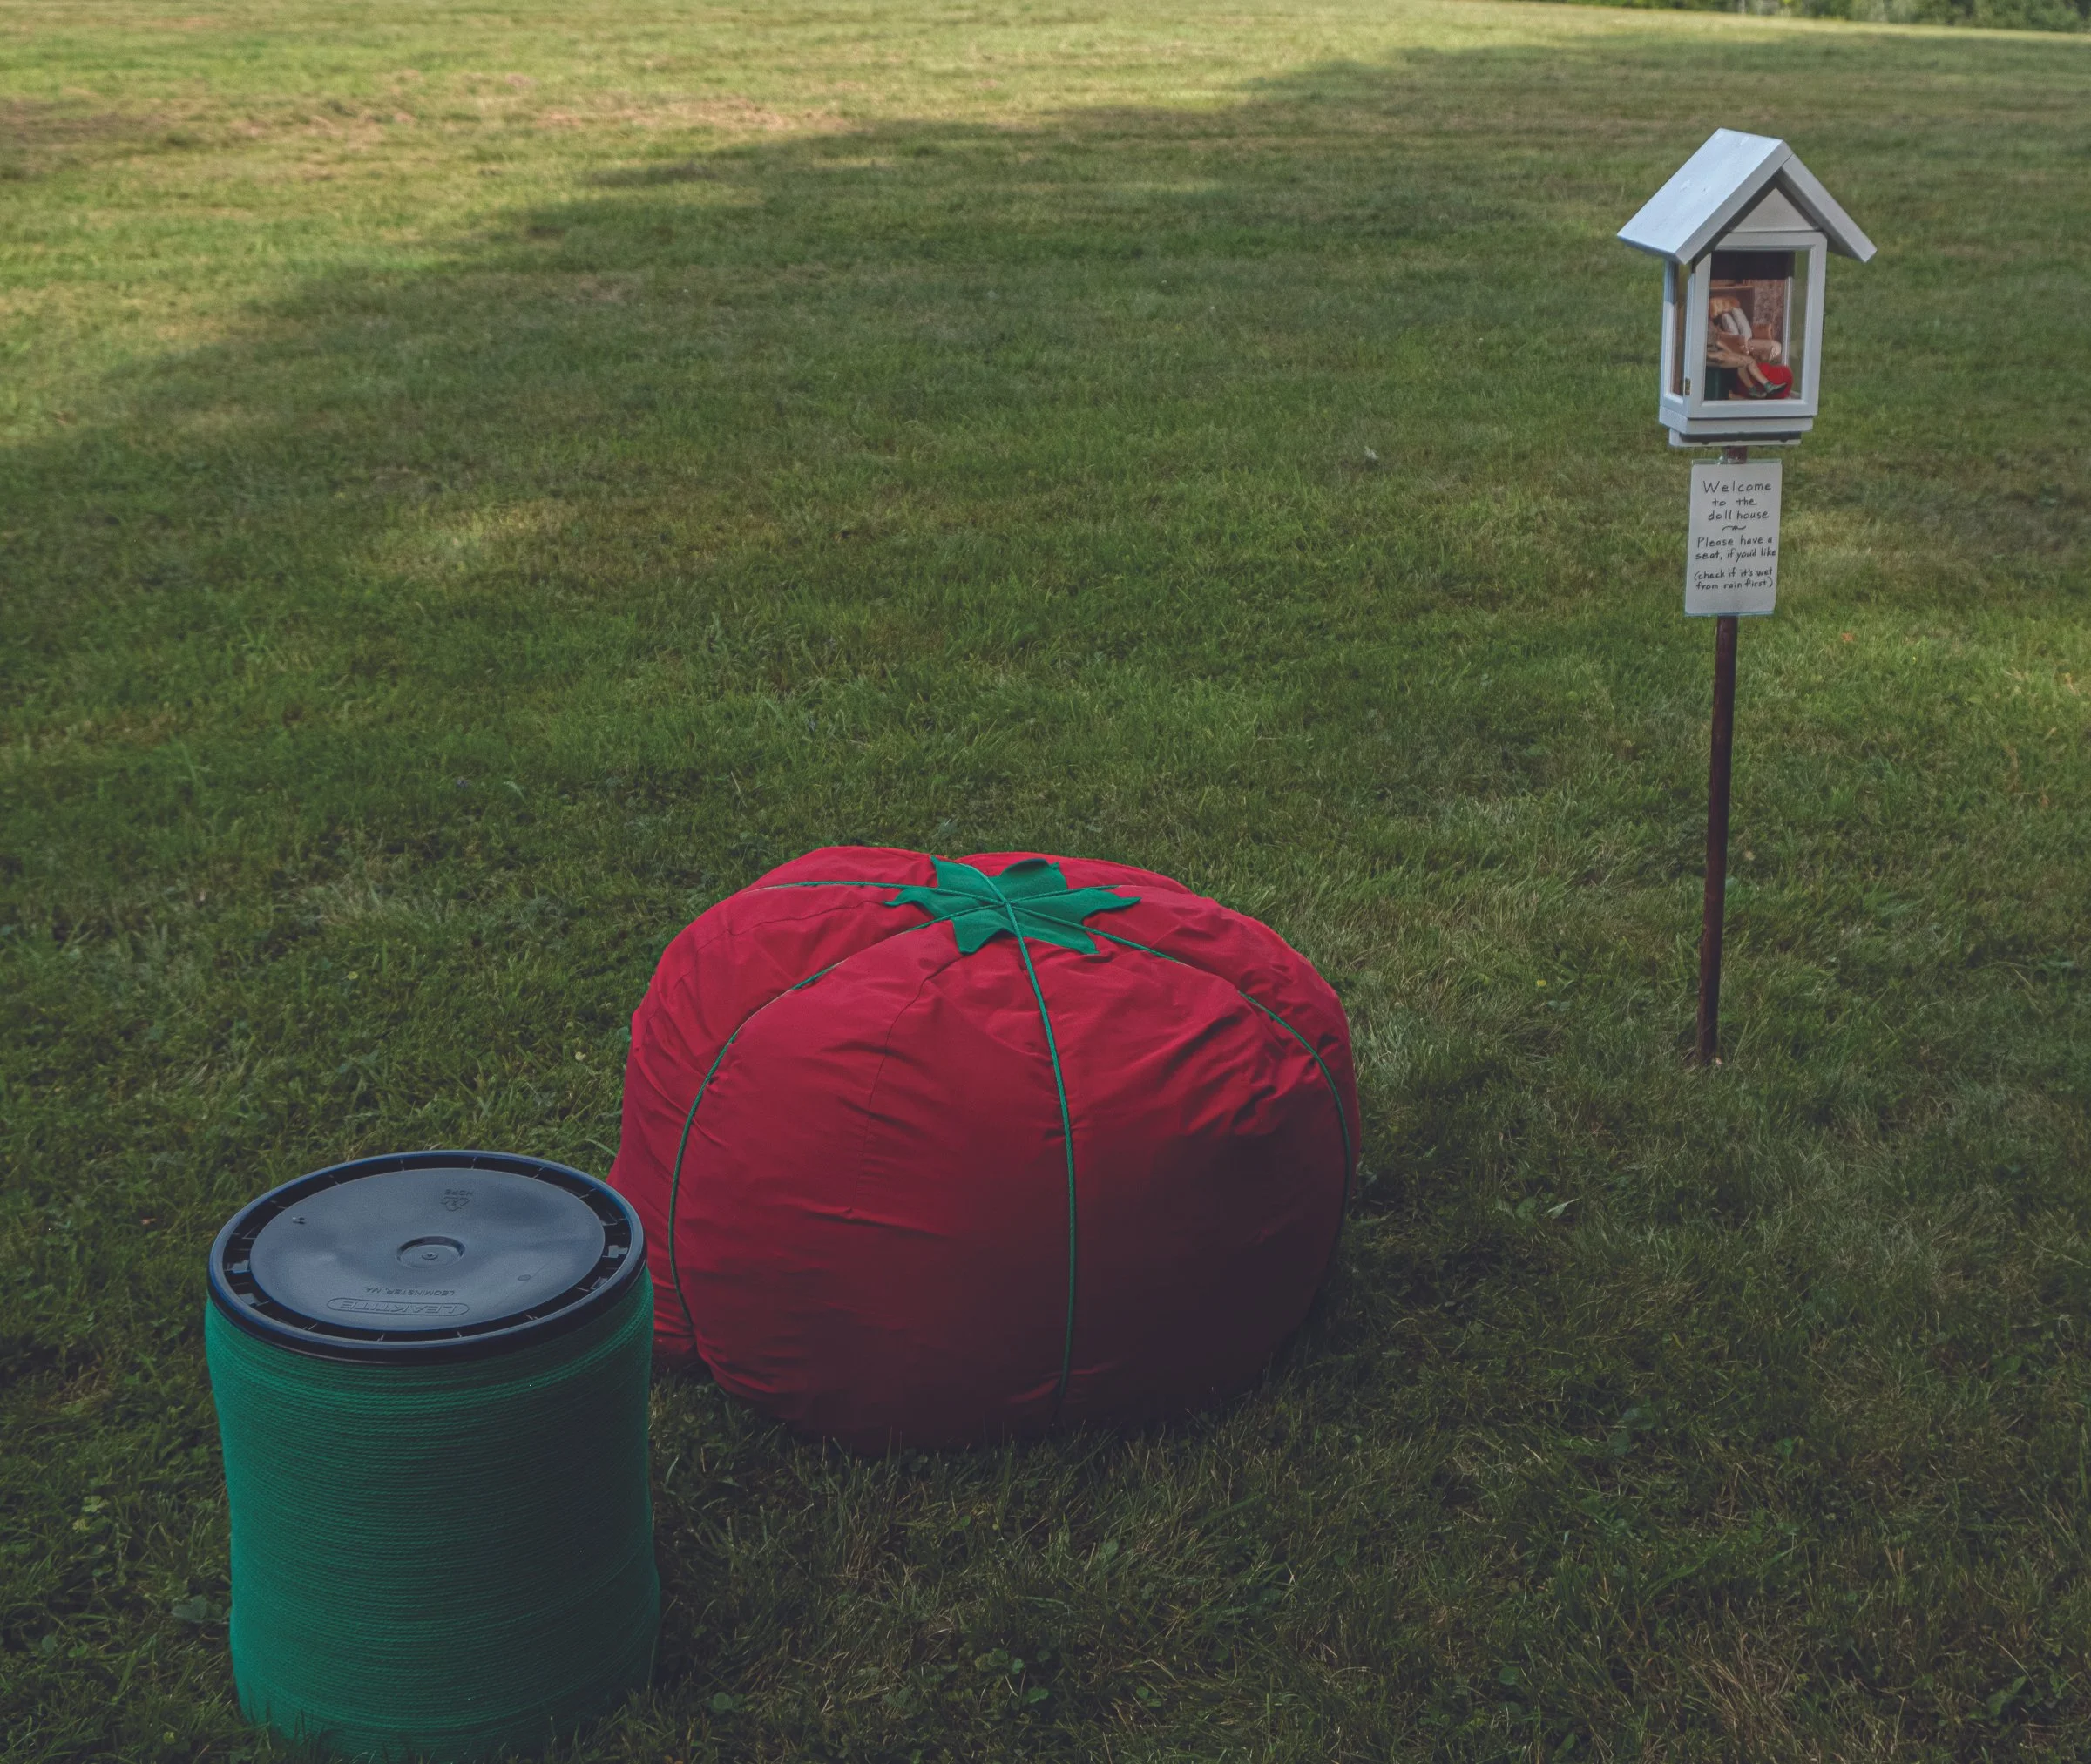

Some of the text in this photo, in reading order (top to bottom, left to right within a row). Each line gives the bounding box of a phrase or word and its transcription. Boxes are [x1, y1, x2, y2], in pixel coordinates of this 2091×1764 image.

[1703, 481, 1771, 493] Welcome
[1708, 510, 1769, 521] doll house
[1697, 537, 1734, 548] Please
[1740, 535, 1763, 545] have
[1727, 549, 1736, 558] if
[1761, 546, 1776, 557] like
[1729, 567, 1736, 578] if
[340, 1301, 457, 1314] LEAKTITE
